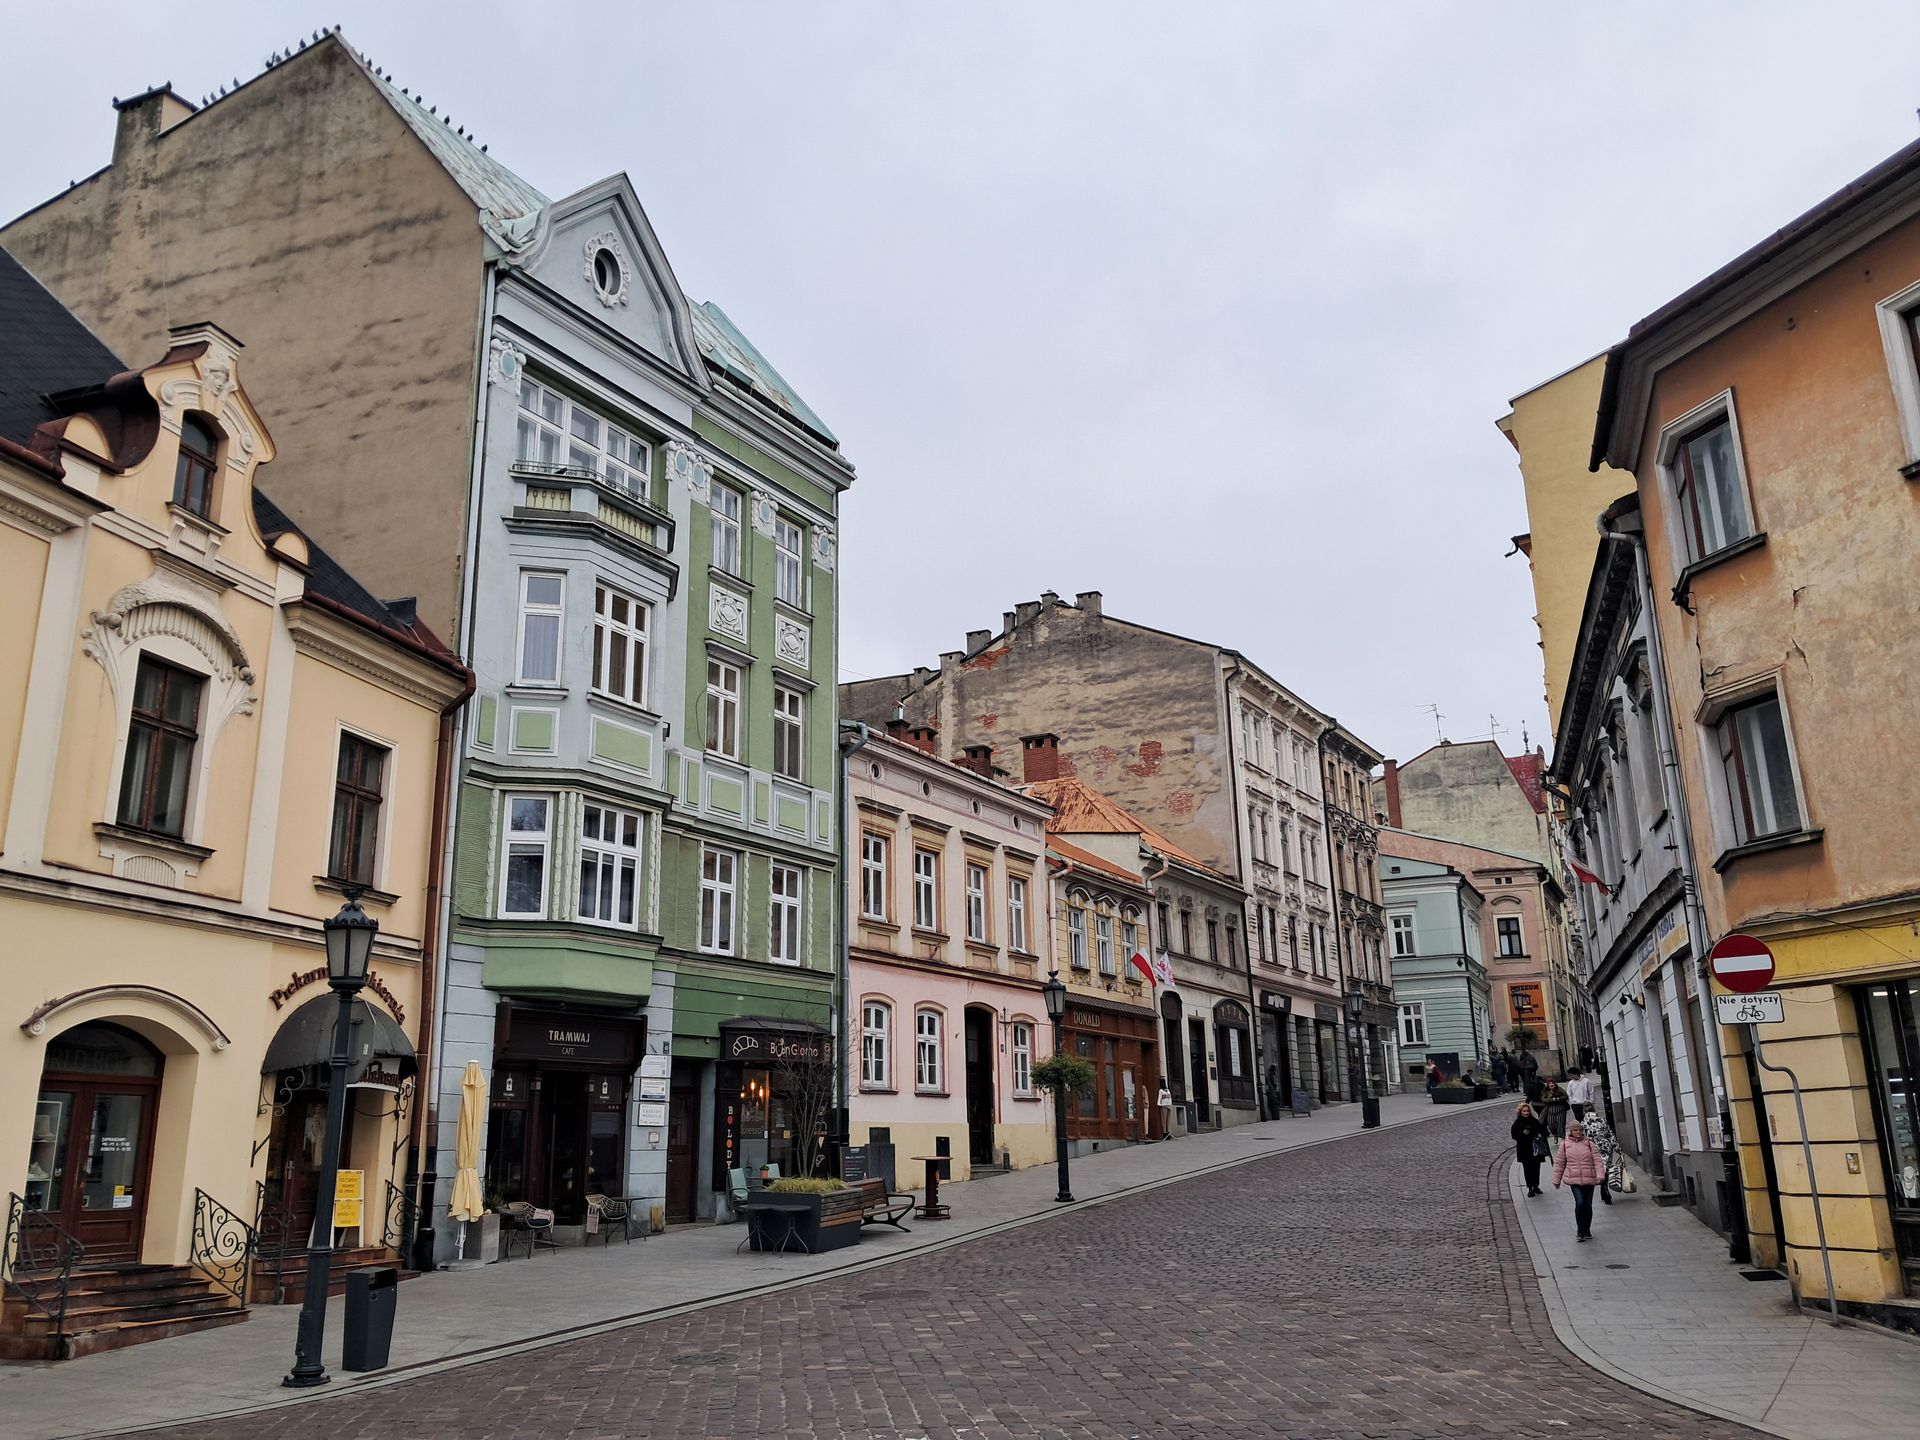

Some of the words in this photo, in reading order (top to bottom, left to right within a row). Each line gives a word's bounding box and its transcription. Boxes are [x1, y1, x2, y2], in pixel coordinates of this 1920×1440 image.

[1720, 996, 1737, 1005] Nie
[1741, 996, 1779, 1005] dotyczy
[1073, 1011, 1100, 1028] DONALD
[549, 1030, 591, 1043] TRAMWAJ
[561, 1047, 575, 1056] CAFE
